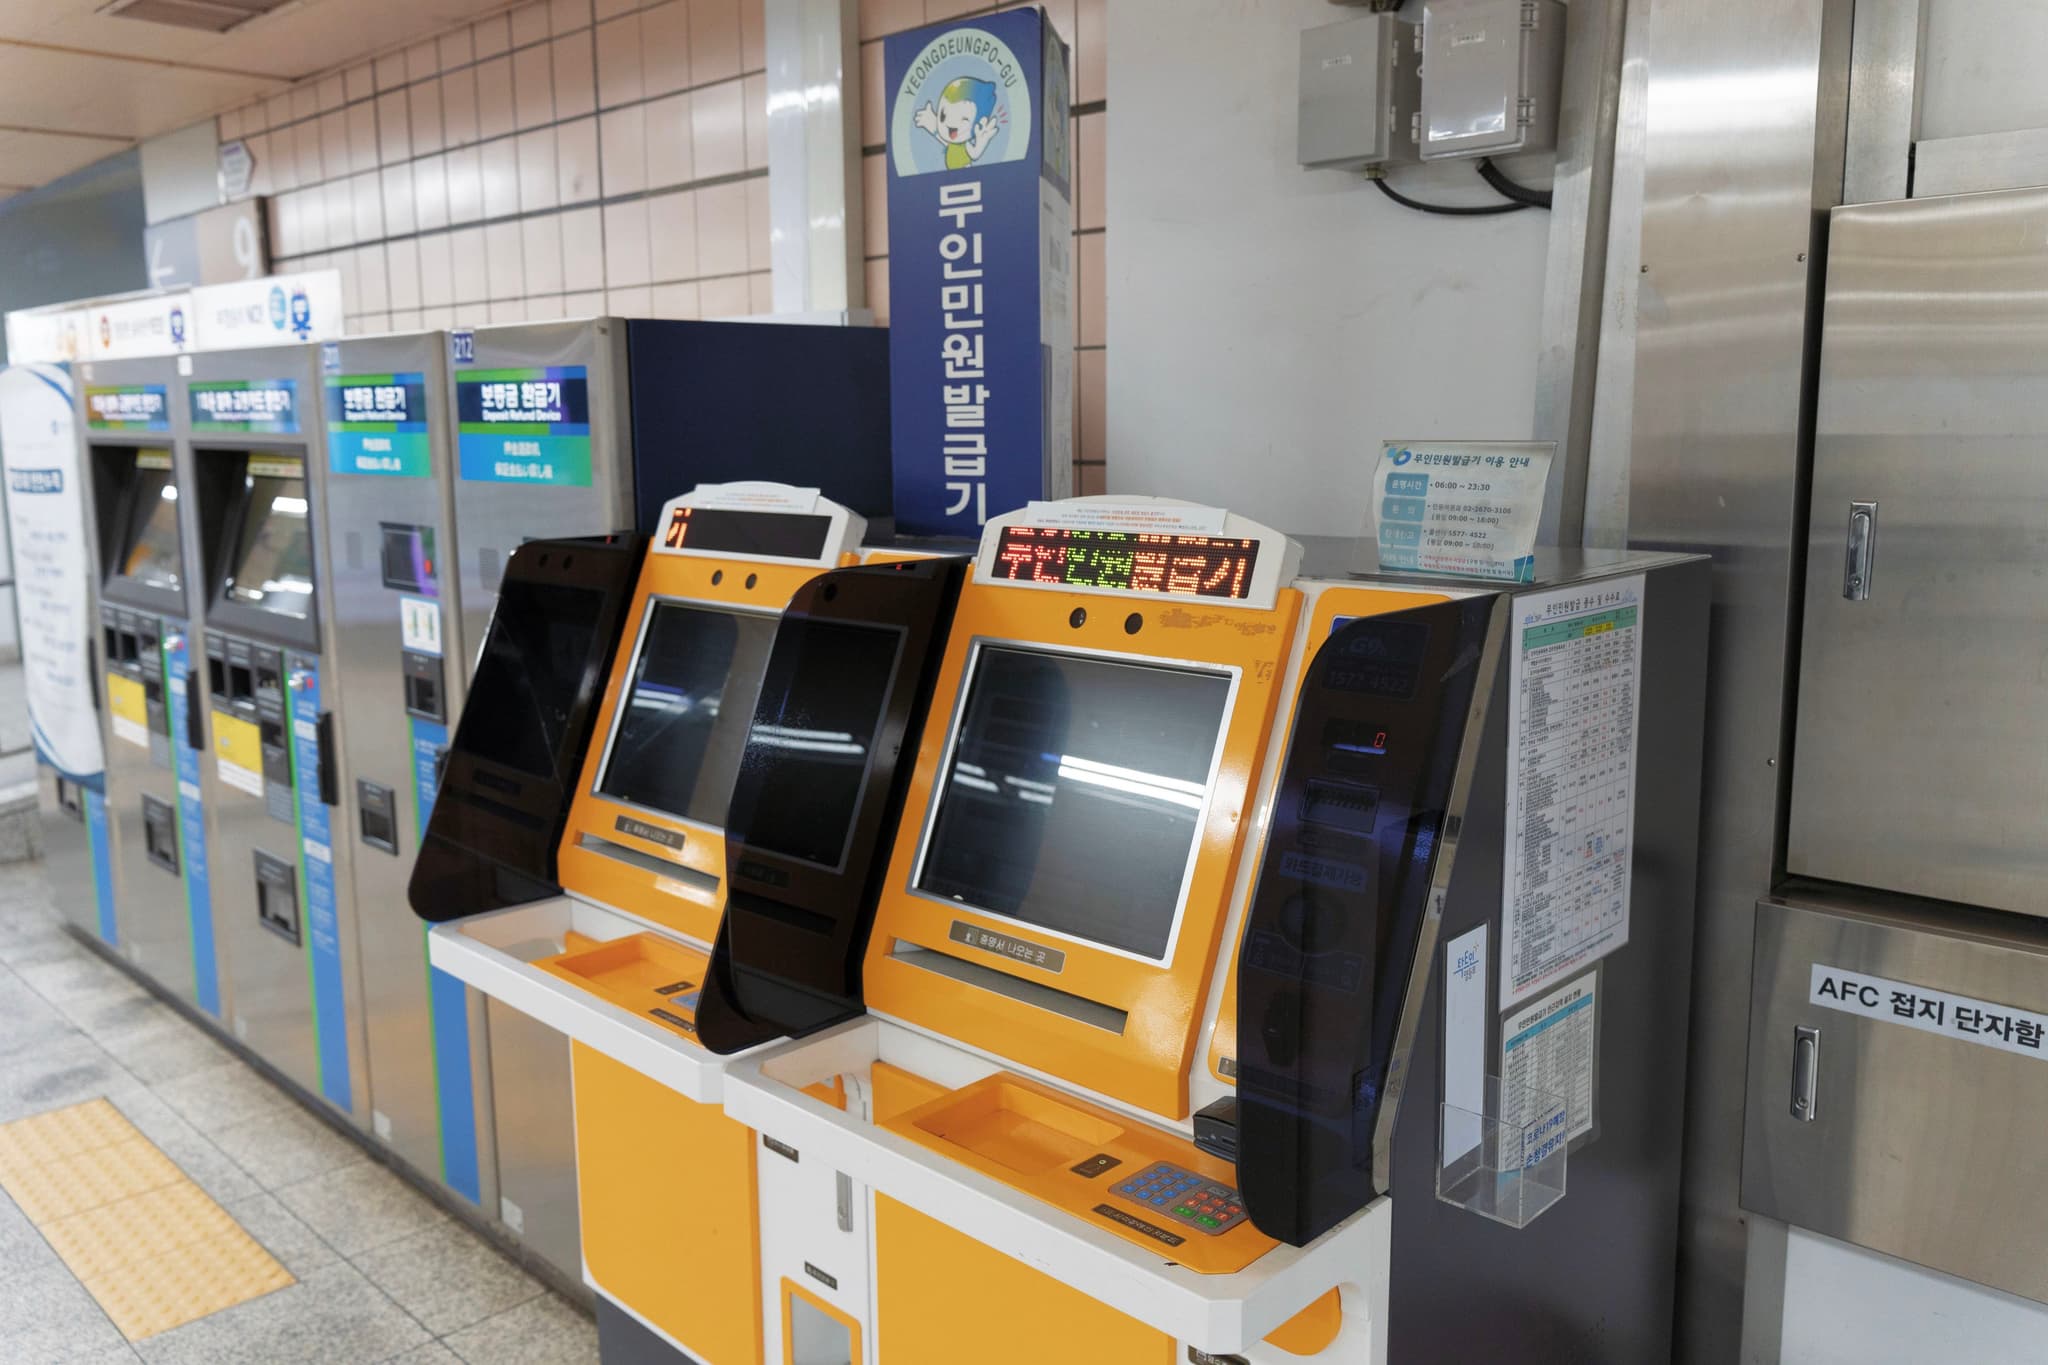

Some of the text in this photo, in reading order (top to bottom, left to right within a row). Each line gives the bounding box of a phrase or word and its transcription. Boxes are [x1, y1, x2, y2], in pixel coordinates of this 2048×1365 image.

[904, 36, 1017, 98] YEONGDEUNGPO-GU
[938, 181, 990, 526] 무인민원발급기
[481, 382, 562, 410] 보증금 환급기
[1485, 456, 1505, 469] 이용
[1435, 481, 1458, 490] 06:00
[1467, 482, 1491, 492] 23:30
[1373, 732, 1386, 747] 0
[1817, 976, 2045, 1049] AFC 접지 단자함
